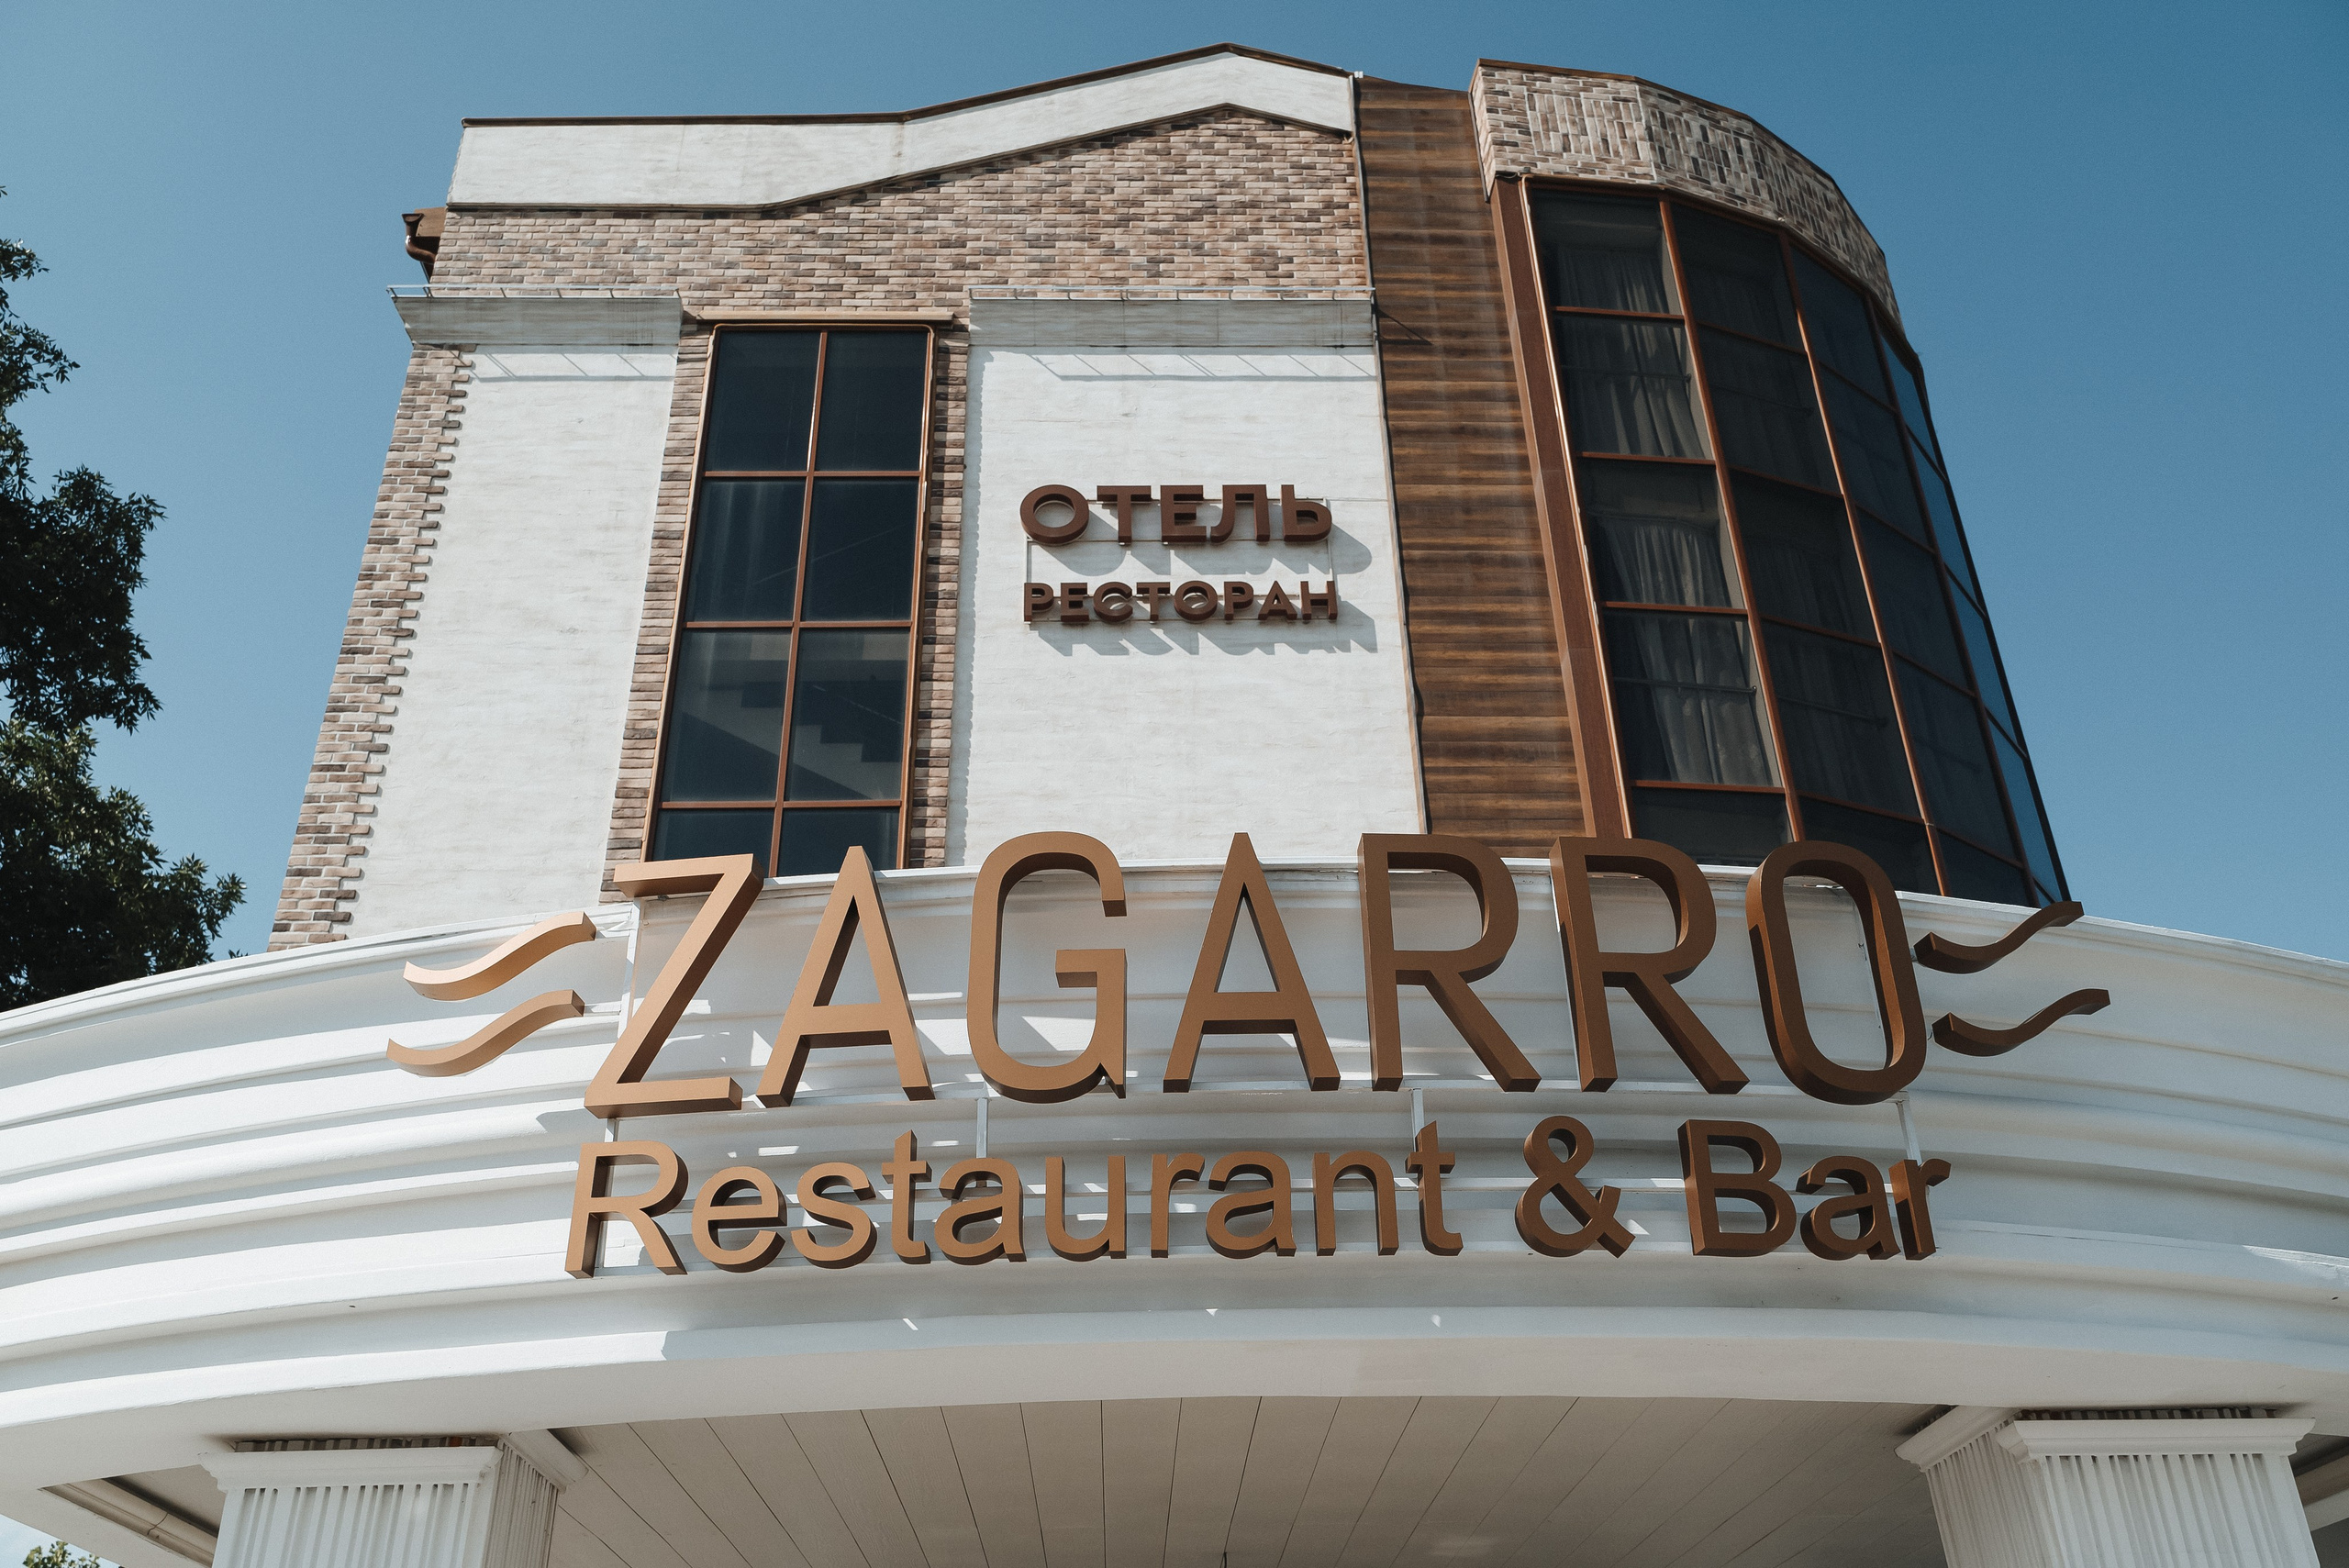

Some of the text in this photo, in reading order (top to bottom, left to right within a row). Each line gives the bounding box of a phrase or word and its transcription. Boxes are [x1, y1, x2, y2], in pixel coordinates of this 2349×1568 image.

[1020, 484, 1332, 544] ОТЕЛЬ
[1024, 580, 1338, 622] РЕСТОРАН
[584, 831, 1928, 1118] ZAGARRO
[564, 1116, 1951, 1279] Restaurant & Bar
